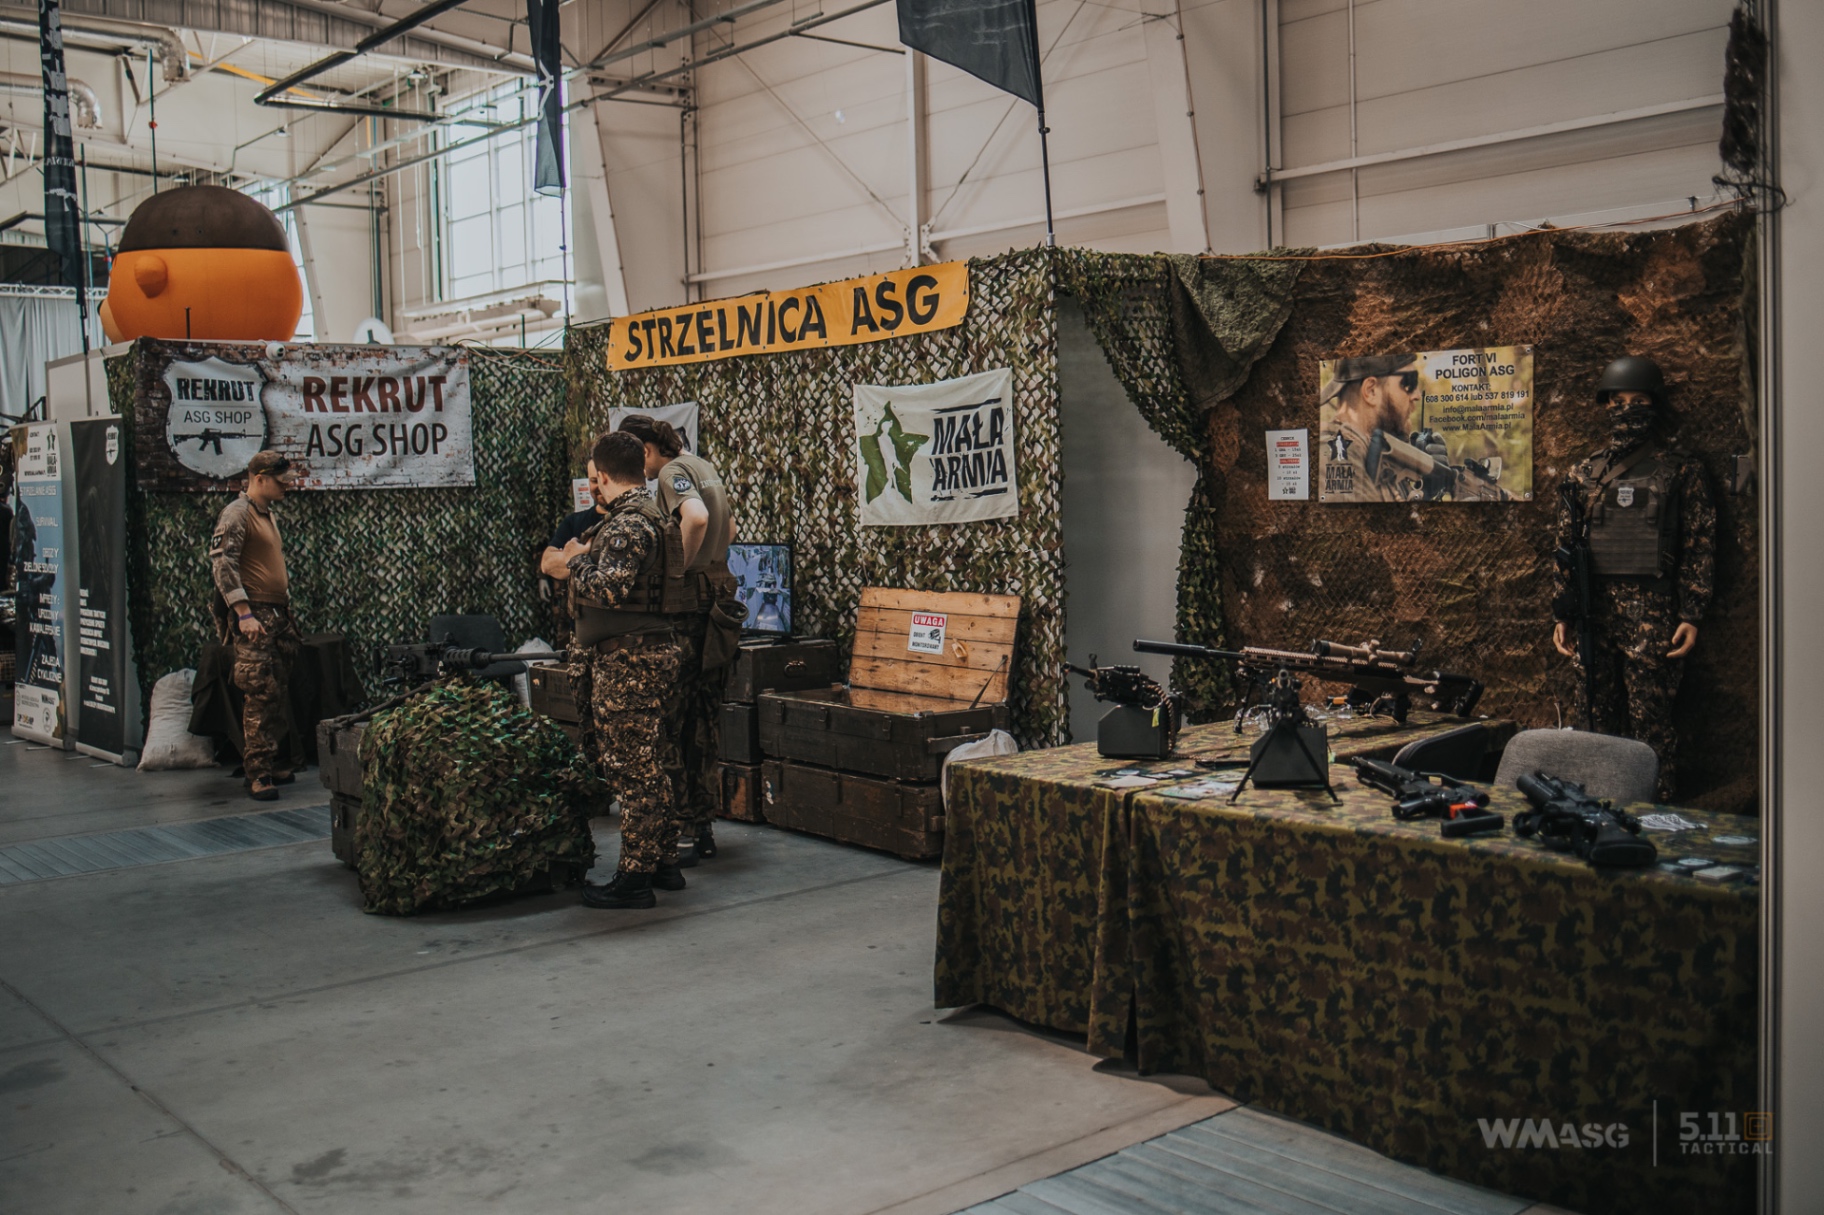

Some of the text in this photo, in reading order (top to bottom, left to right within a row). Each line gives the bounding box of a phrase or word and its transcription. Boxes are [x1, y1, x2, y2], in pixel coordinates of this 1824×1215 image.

[624, 274, 940, 362] STRZELNICA ASG
[1452, 352, 1497, 366] FORT VI
[1435, 365, 1515, 380] POLIGON ASG
[176, 377, 255, 402] REKRUT
[303, 375, 448, 413] REKRUT
[1451, 383, 1491, 392] KONTAKT:
[1455, 393, 1469, 401] 614
[1485, 392, 1498, 400] 537
[1500, 391, 1514, 399] 819
[1517, 390, 1530, 398] 191
[1443, 403, 1514, 414] info@malaarmia.pl
[184, 410, 253, 425] ASG SHOP
[1429, 412, 1525, 423] Facebook.com/malaarmia
[932, 407, 1004, 455] MAŁA
[1442, 421, 1512, 432] www.MalaArmia.pl
[305, 422, 448, 458] ASG SHOP
[931, 448, 1008, 491] ARMIA
[1326, 466, 1354, 479] MAŁA
[1325, 479, 1353, 491] ARMIA
[914, 615, 944, 627] UWAGA
